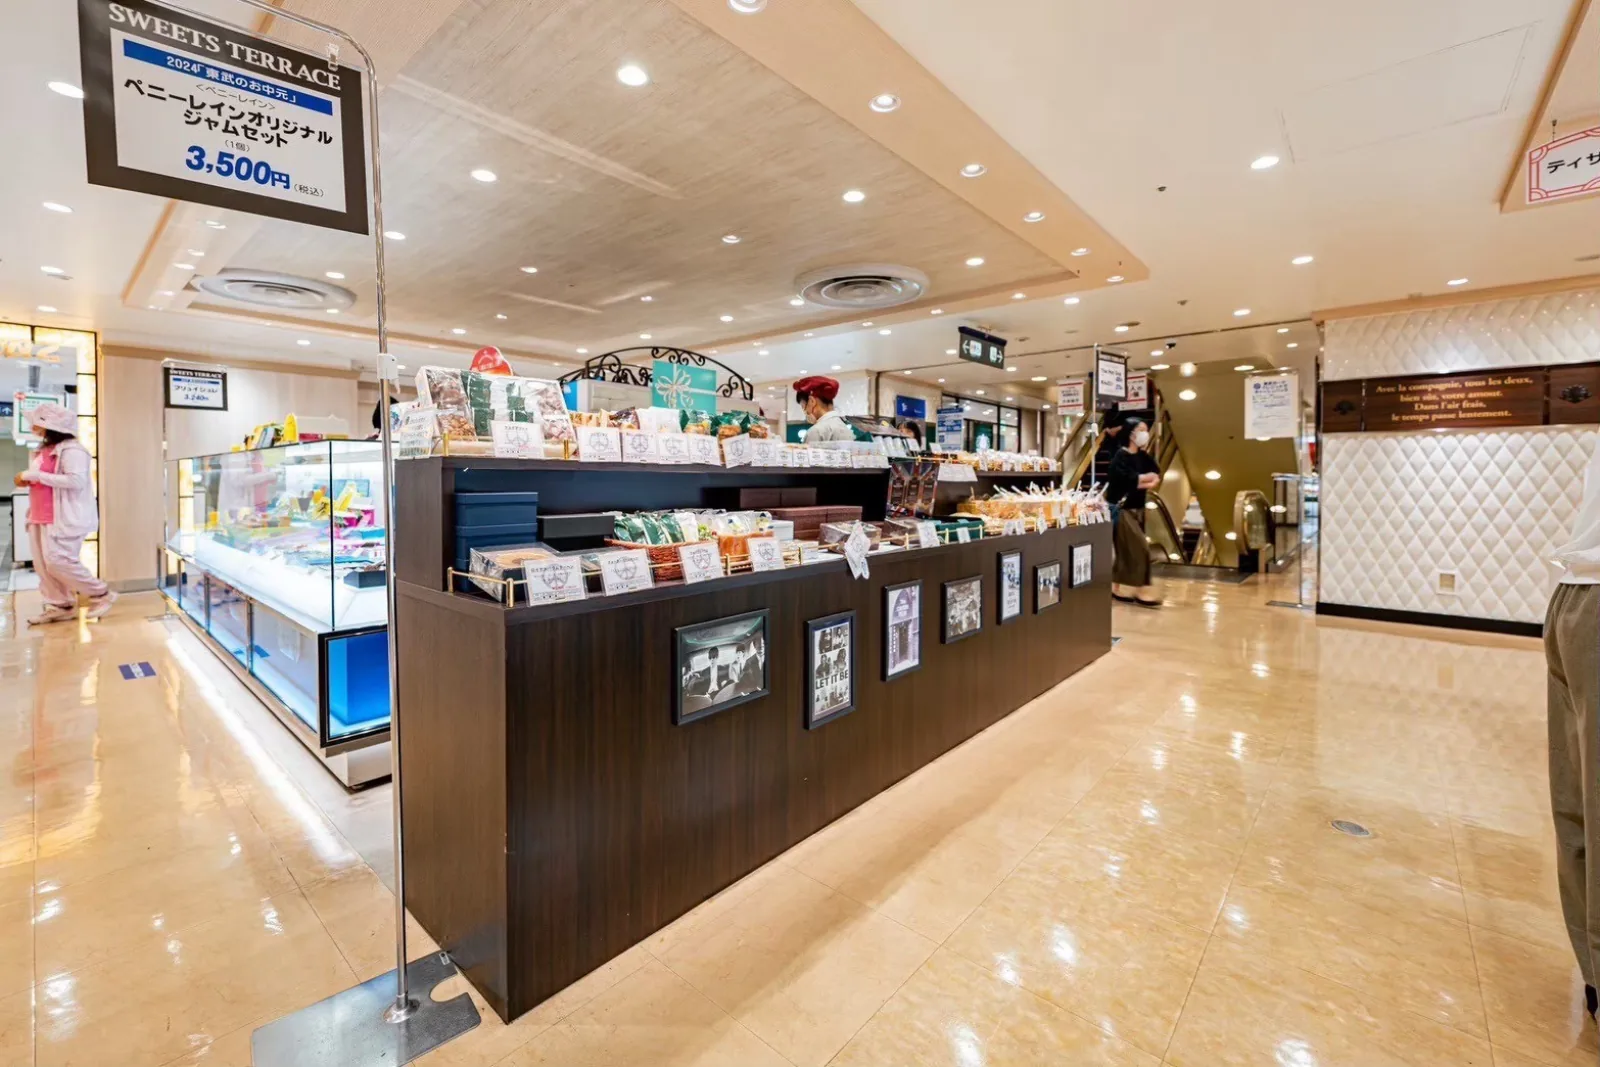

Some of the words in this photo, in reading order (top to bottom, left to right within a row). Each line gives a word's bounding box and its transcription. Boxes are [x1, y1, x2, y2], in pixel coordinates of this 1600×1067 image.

[109, 4, 221, 52] SWEETS
[226, 40, 341, 91] TERRACE
[166, 55, 297, 104] 2024「東武のお中元」
[124, 77, 333, 145] ペニーレインオリジナル
[184, 110, 288, 148] ジャムセット
[185, 145, 290, 189] 3,500円
[1398, 384, 1407, 392] la
[1488, 377, 1502, 385] les
[1400, 394, 1420, 402] bien
[1391, 413, 1399, 421] le
[1431, 413, 1456, 421] passe
[816, 677, 829, 690] LET
[831, 674, 838, 684] IT
[840, 670, 848, 681] BE
